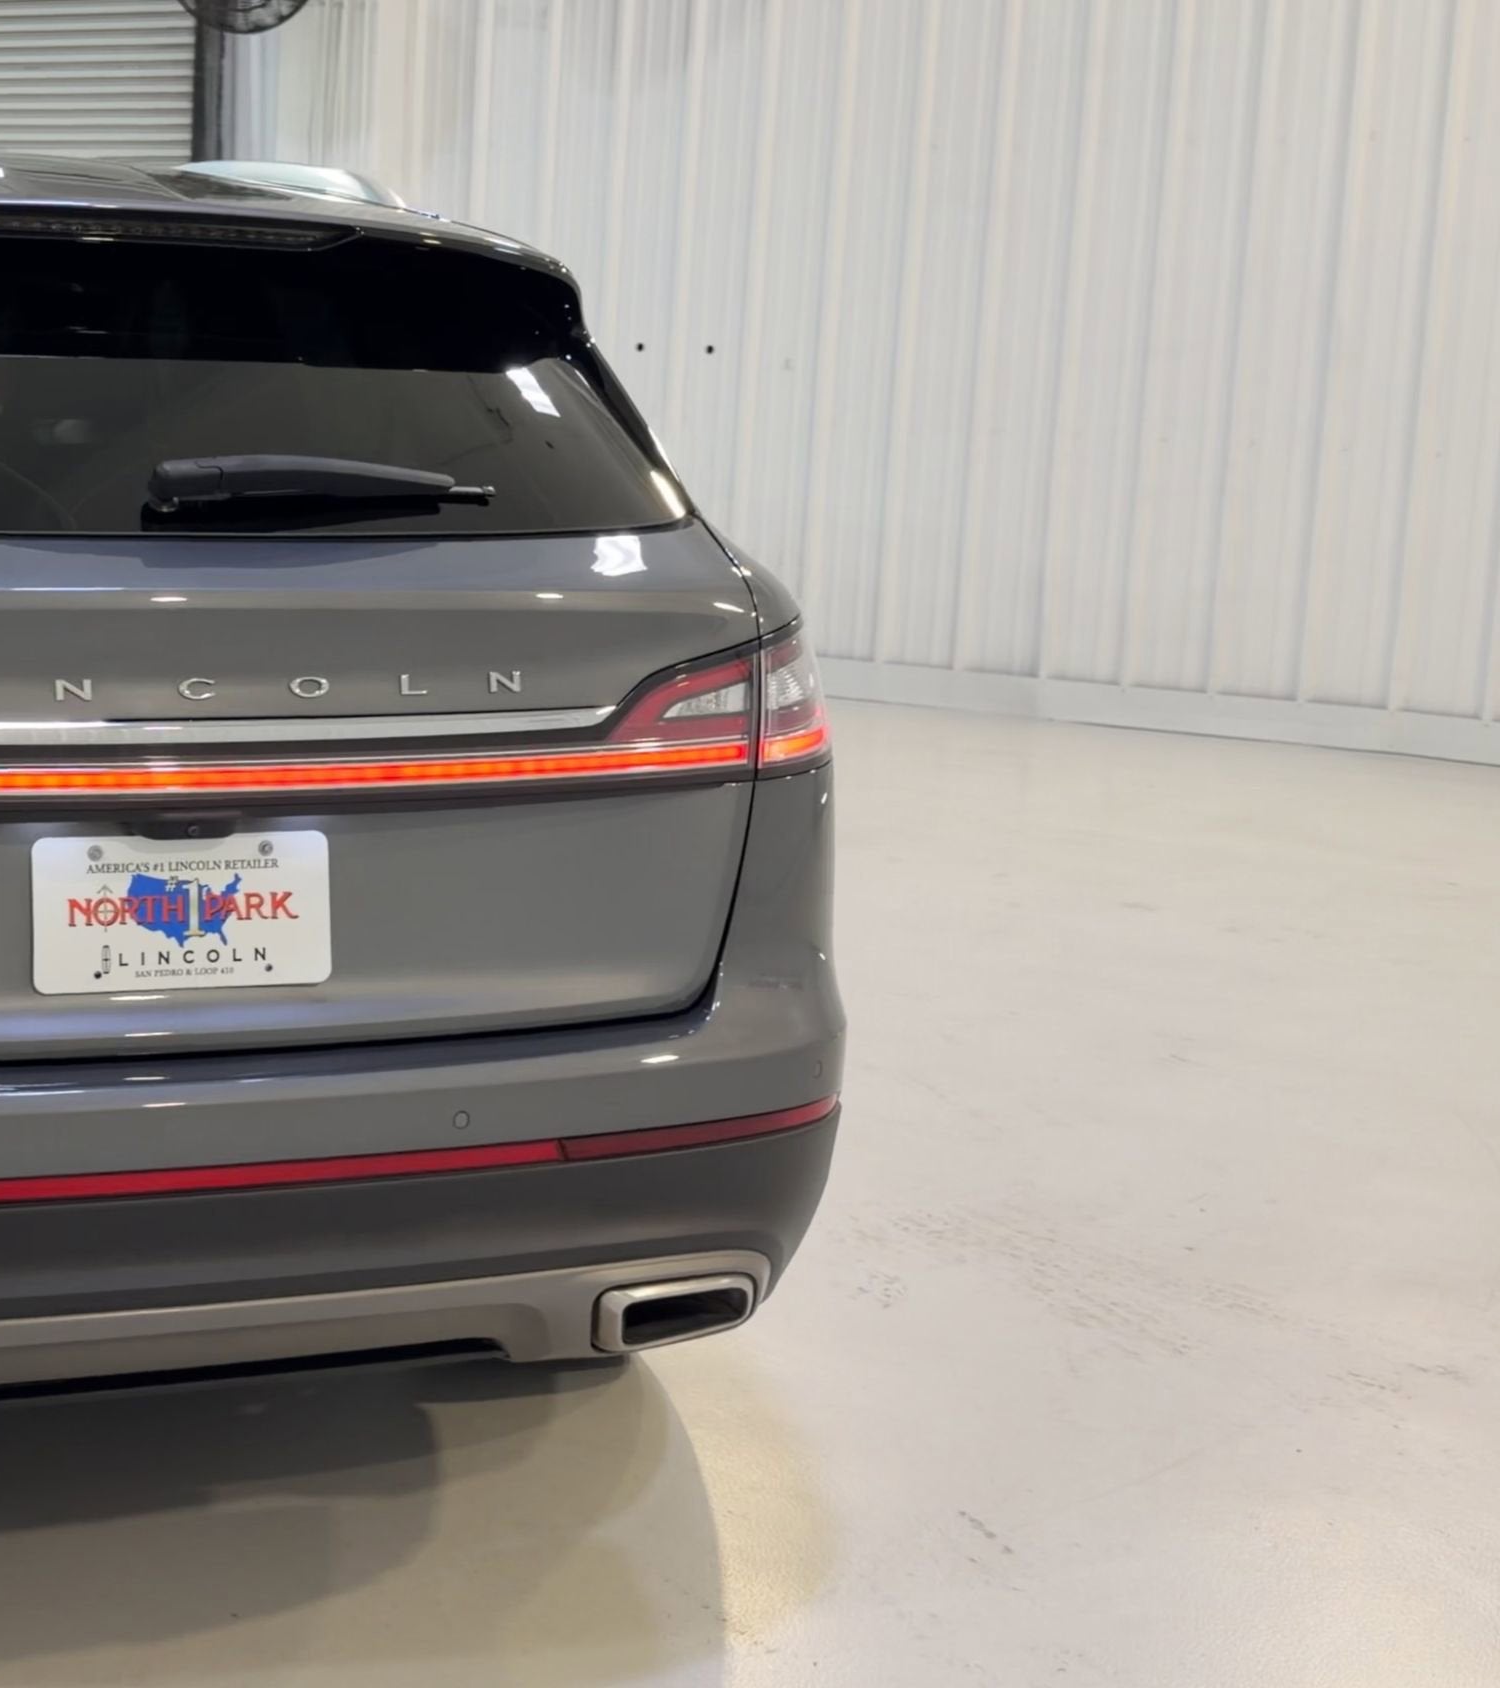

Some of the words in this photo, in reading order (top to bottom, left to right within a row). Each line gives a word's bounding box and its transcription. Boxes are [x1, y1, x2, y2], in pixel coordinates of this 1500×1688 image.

[86, 862, 150, 875] AMERICA'S
[153, 862, 165, 873] #1
[168, 860, 222, 873] LINCOLN
[224, 858, 279, 871] RETAILER
[67, 896, 185, 927] NORTH
[204, 891, 299, 923] PARK
[118, 947, 267, 967] LINCOLN
[135, 970, 152, 978] SAN
[154, 969, 183, 977] PEDRO
[194, 967, 218, 975] LOOP
